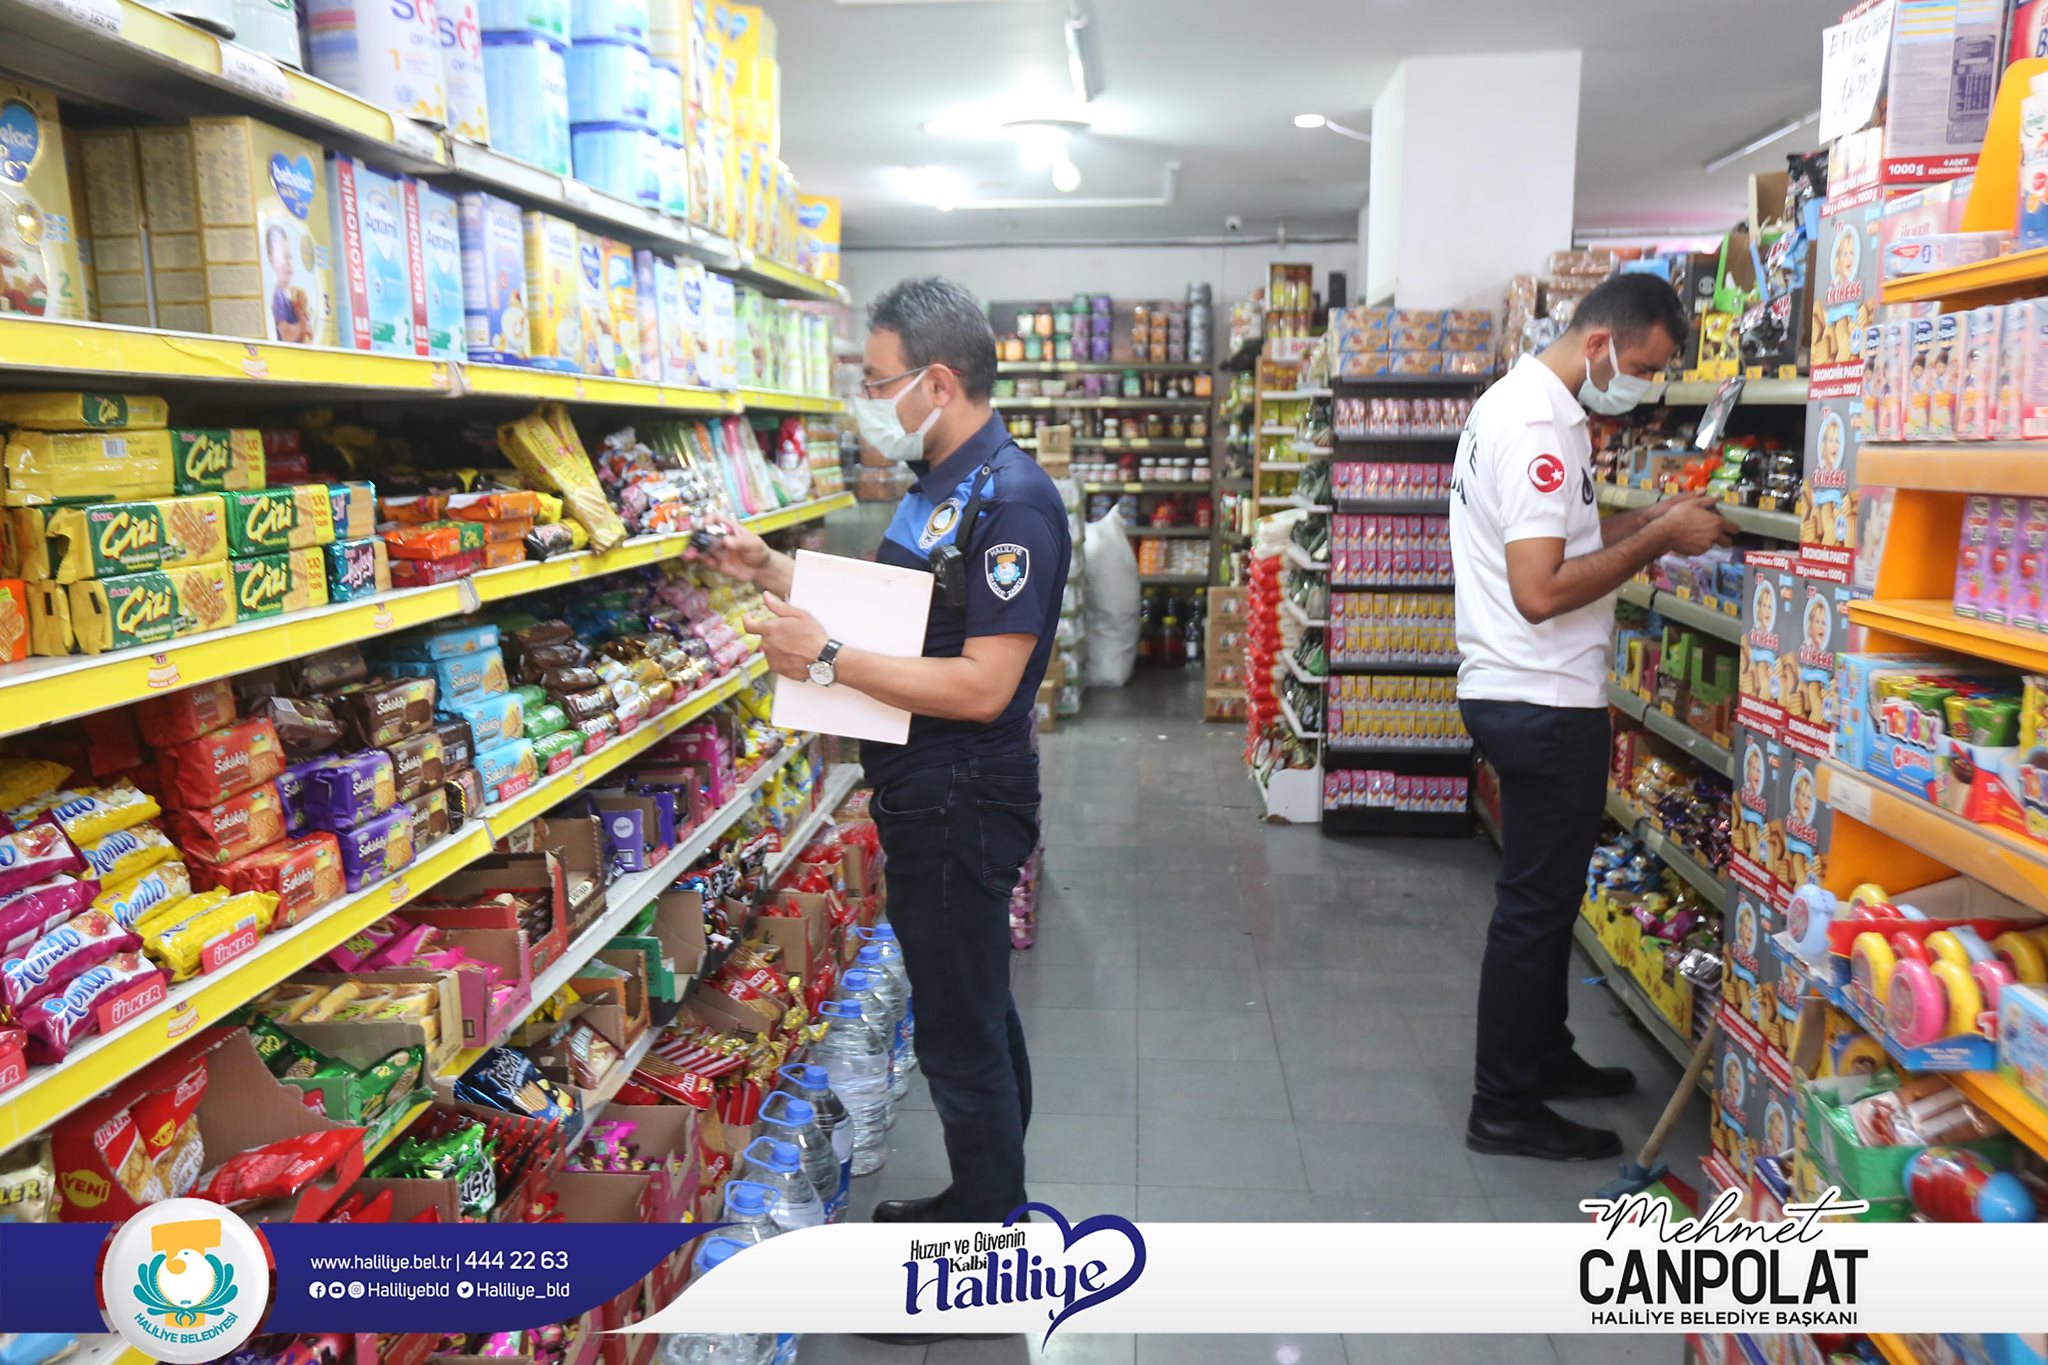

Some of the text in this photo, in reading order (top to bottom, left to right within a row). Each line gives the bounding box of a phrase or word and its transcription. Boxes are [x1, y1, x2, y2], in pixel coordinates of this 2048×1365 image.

[82, 831, 138, 877] Rondo
[113, 877, 166, 929] Rondo
[213, 931, 255, 966] ÜLKER
[112, 984, 162, 1025] ÜLKER
[62, 1173, 111, 1199] YENİ
